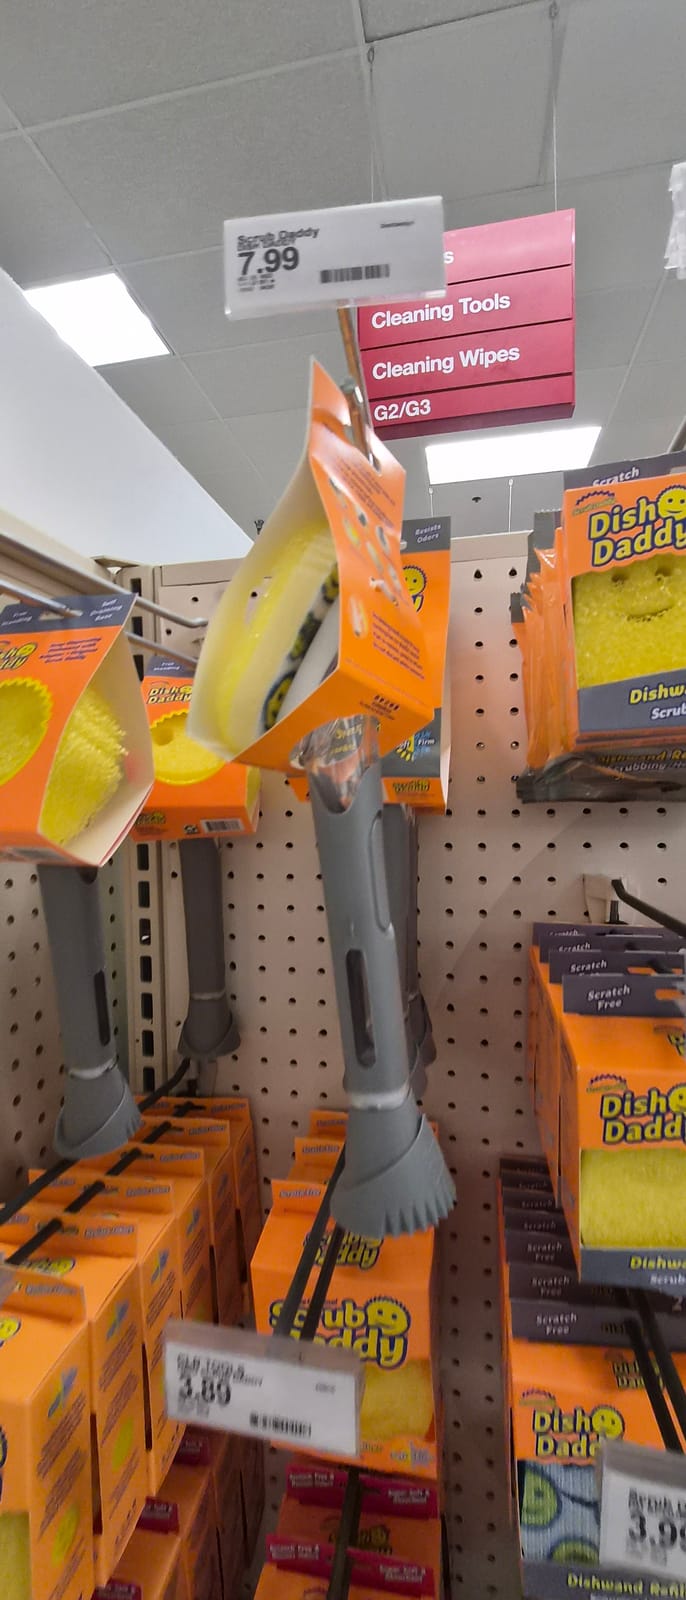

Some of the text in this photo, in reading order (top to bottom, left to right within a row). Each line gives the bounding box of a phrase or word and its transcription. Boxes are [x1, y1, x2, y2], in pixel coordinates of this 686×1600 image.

[237, 226, 320, 244] Scrub Daddy
[237, 246, 300, 276] 7.99
[371, 293, 511, 329] Cleaning Tools
[372, 347, 520, 380] Cleaning Wipes
[373, 398, 432, 421] G2/G3
[592, 466, 641, 486] Scratch
[588, 496, 657, 541] Dish
[416, 533, 440, 544] Odors
[148, 686, 182, 697] Dish
[629, 683, 686, 705] Dishw
[417, 738, 436, 747] Firm
[569, 959, 608, 974] Scratch
[587, 983, 632, 1002] Scratch
[597, 1000, 623, 1011] Free
[601, 1088, 667, 1120] Dish
[603, 1112, 686, 1144] Dadd
[527, 1241, 563, 1253] Scratch
[531, 1275, 570, 1288] Scratch
[536, 1311, 578, 1327] Scratch
[545, 1325, 570, 1336] Free
[177, 1376, 233, 1407] 3.89
[532, 1407, 592, 1434] Dish
[567, 1572, 643, 1595] Dishwand
